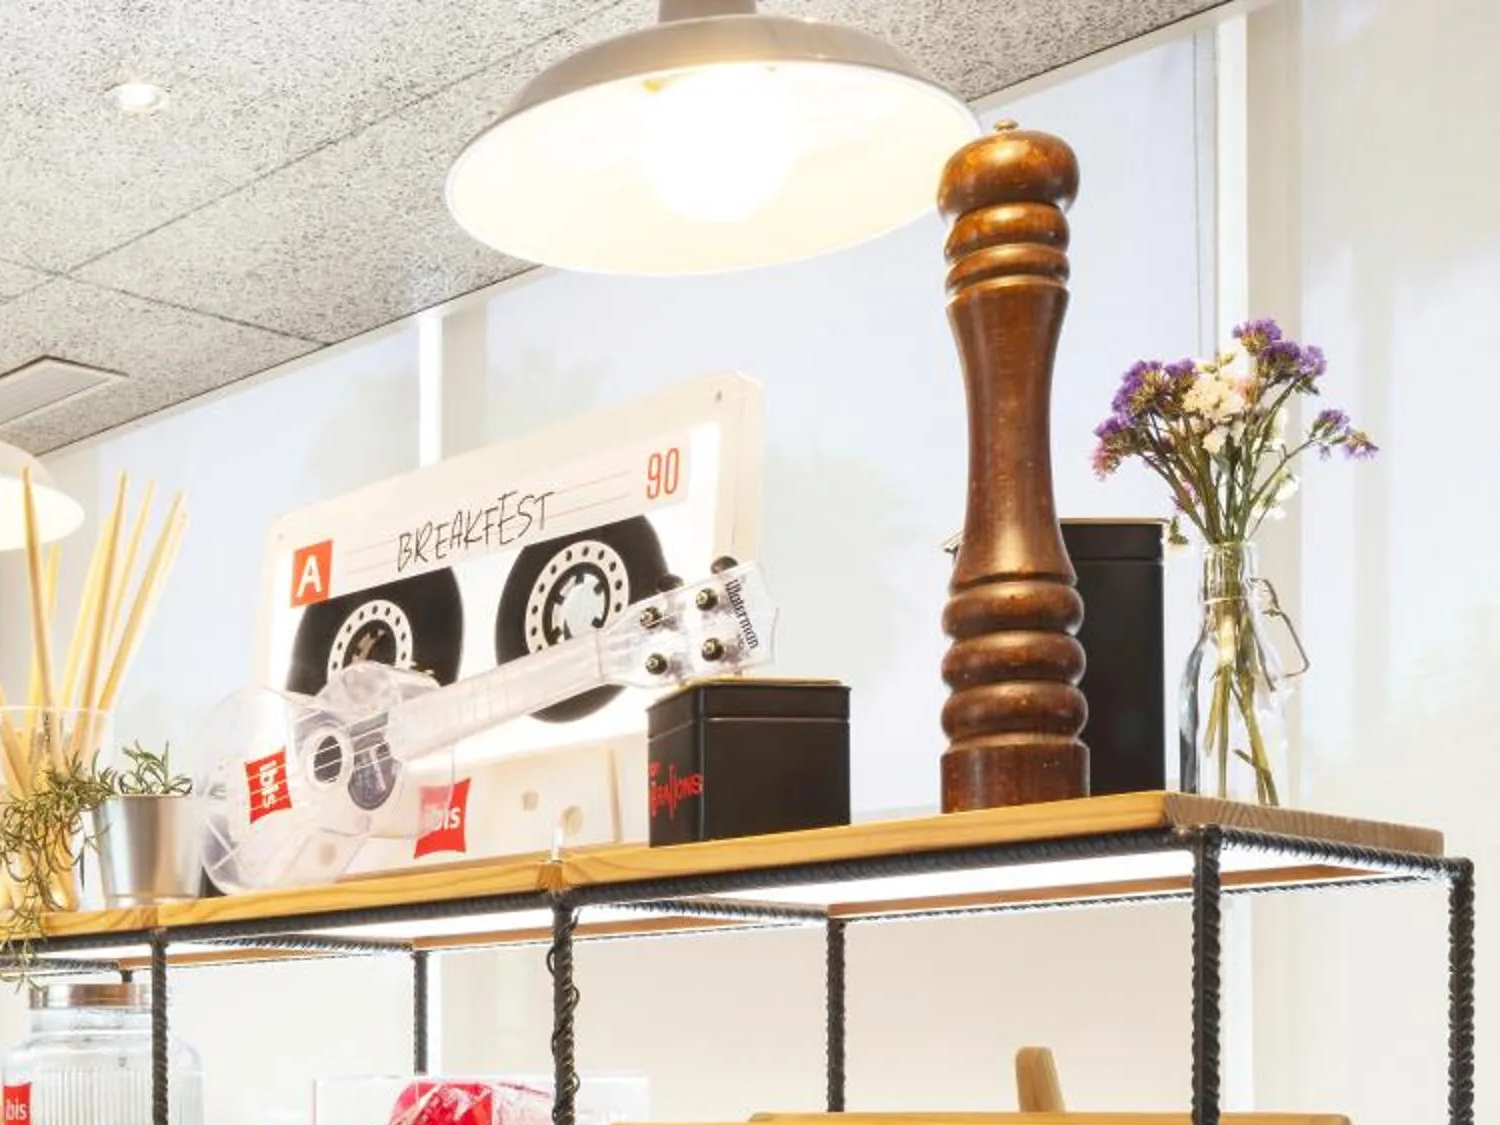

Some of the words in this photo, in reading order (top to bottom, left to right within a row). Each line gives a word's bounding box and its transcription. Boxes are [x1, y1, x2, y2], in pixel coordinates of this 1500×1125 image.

[646, 447, 680, 500] 90
[397, 490, 555, 573] BREAKFEST
[297, 557, 321, 596] A
